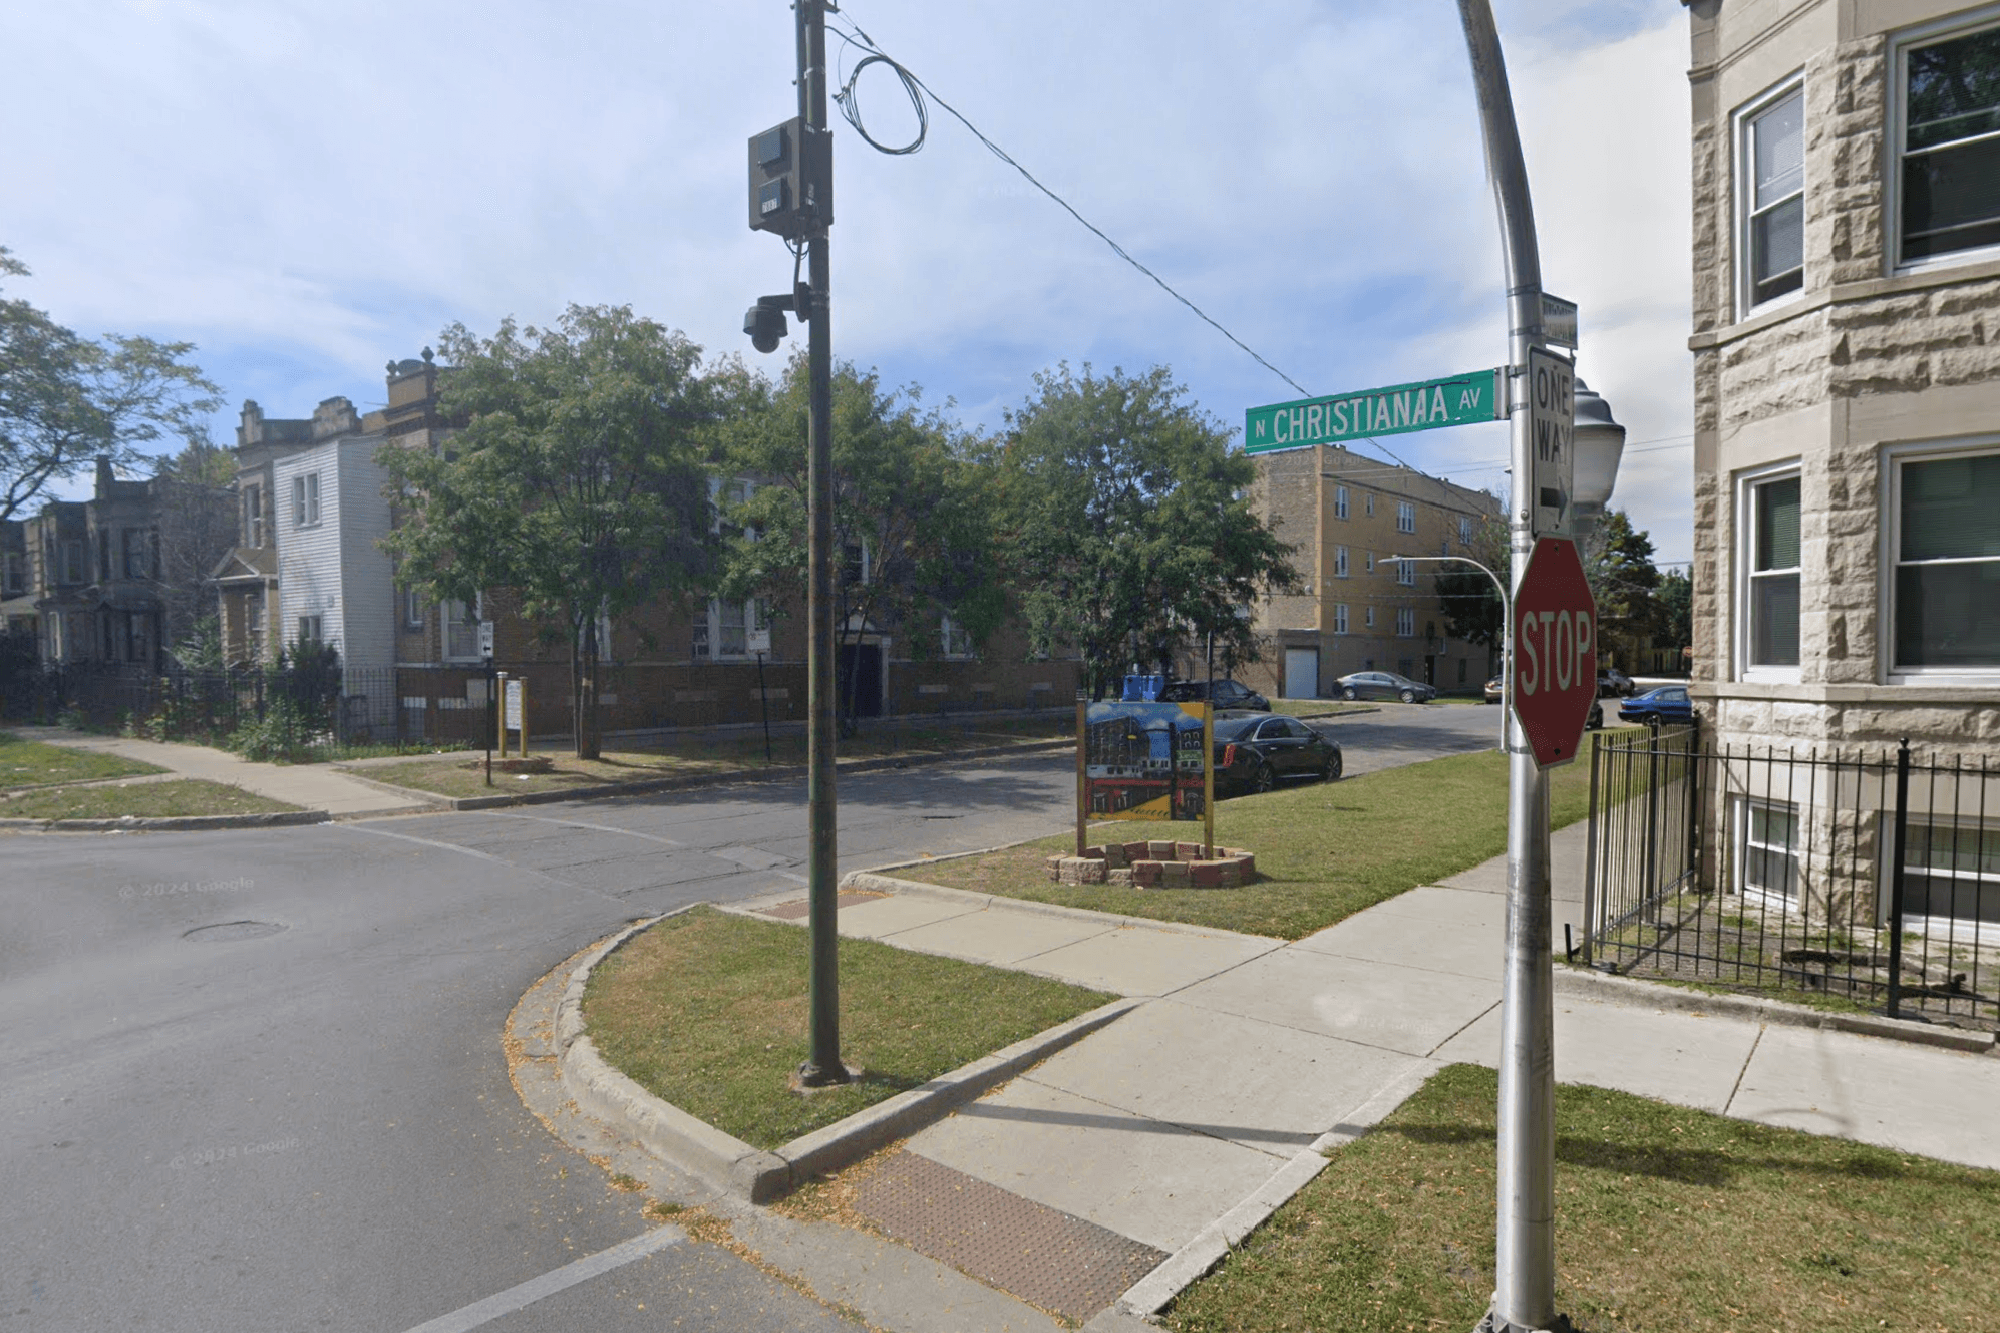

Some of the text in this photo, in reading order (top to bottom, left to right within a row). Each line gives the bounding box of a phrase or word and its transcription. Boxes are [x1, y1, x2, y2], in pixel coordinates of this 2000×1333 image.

[1255, 385, 1481, 444] N CHRISTIANAA AV
[1537, 367, 1570, 416] ONE
[1537, 418, 1570, 466] WAY
[1521, 609, 1592, 697] STOP
